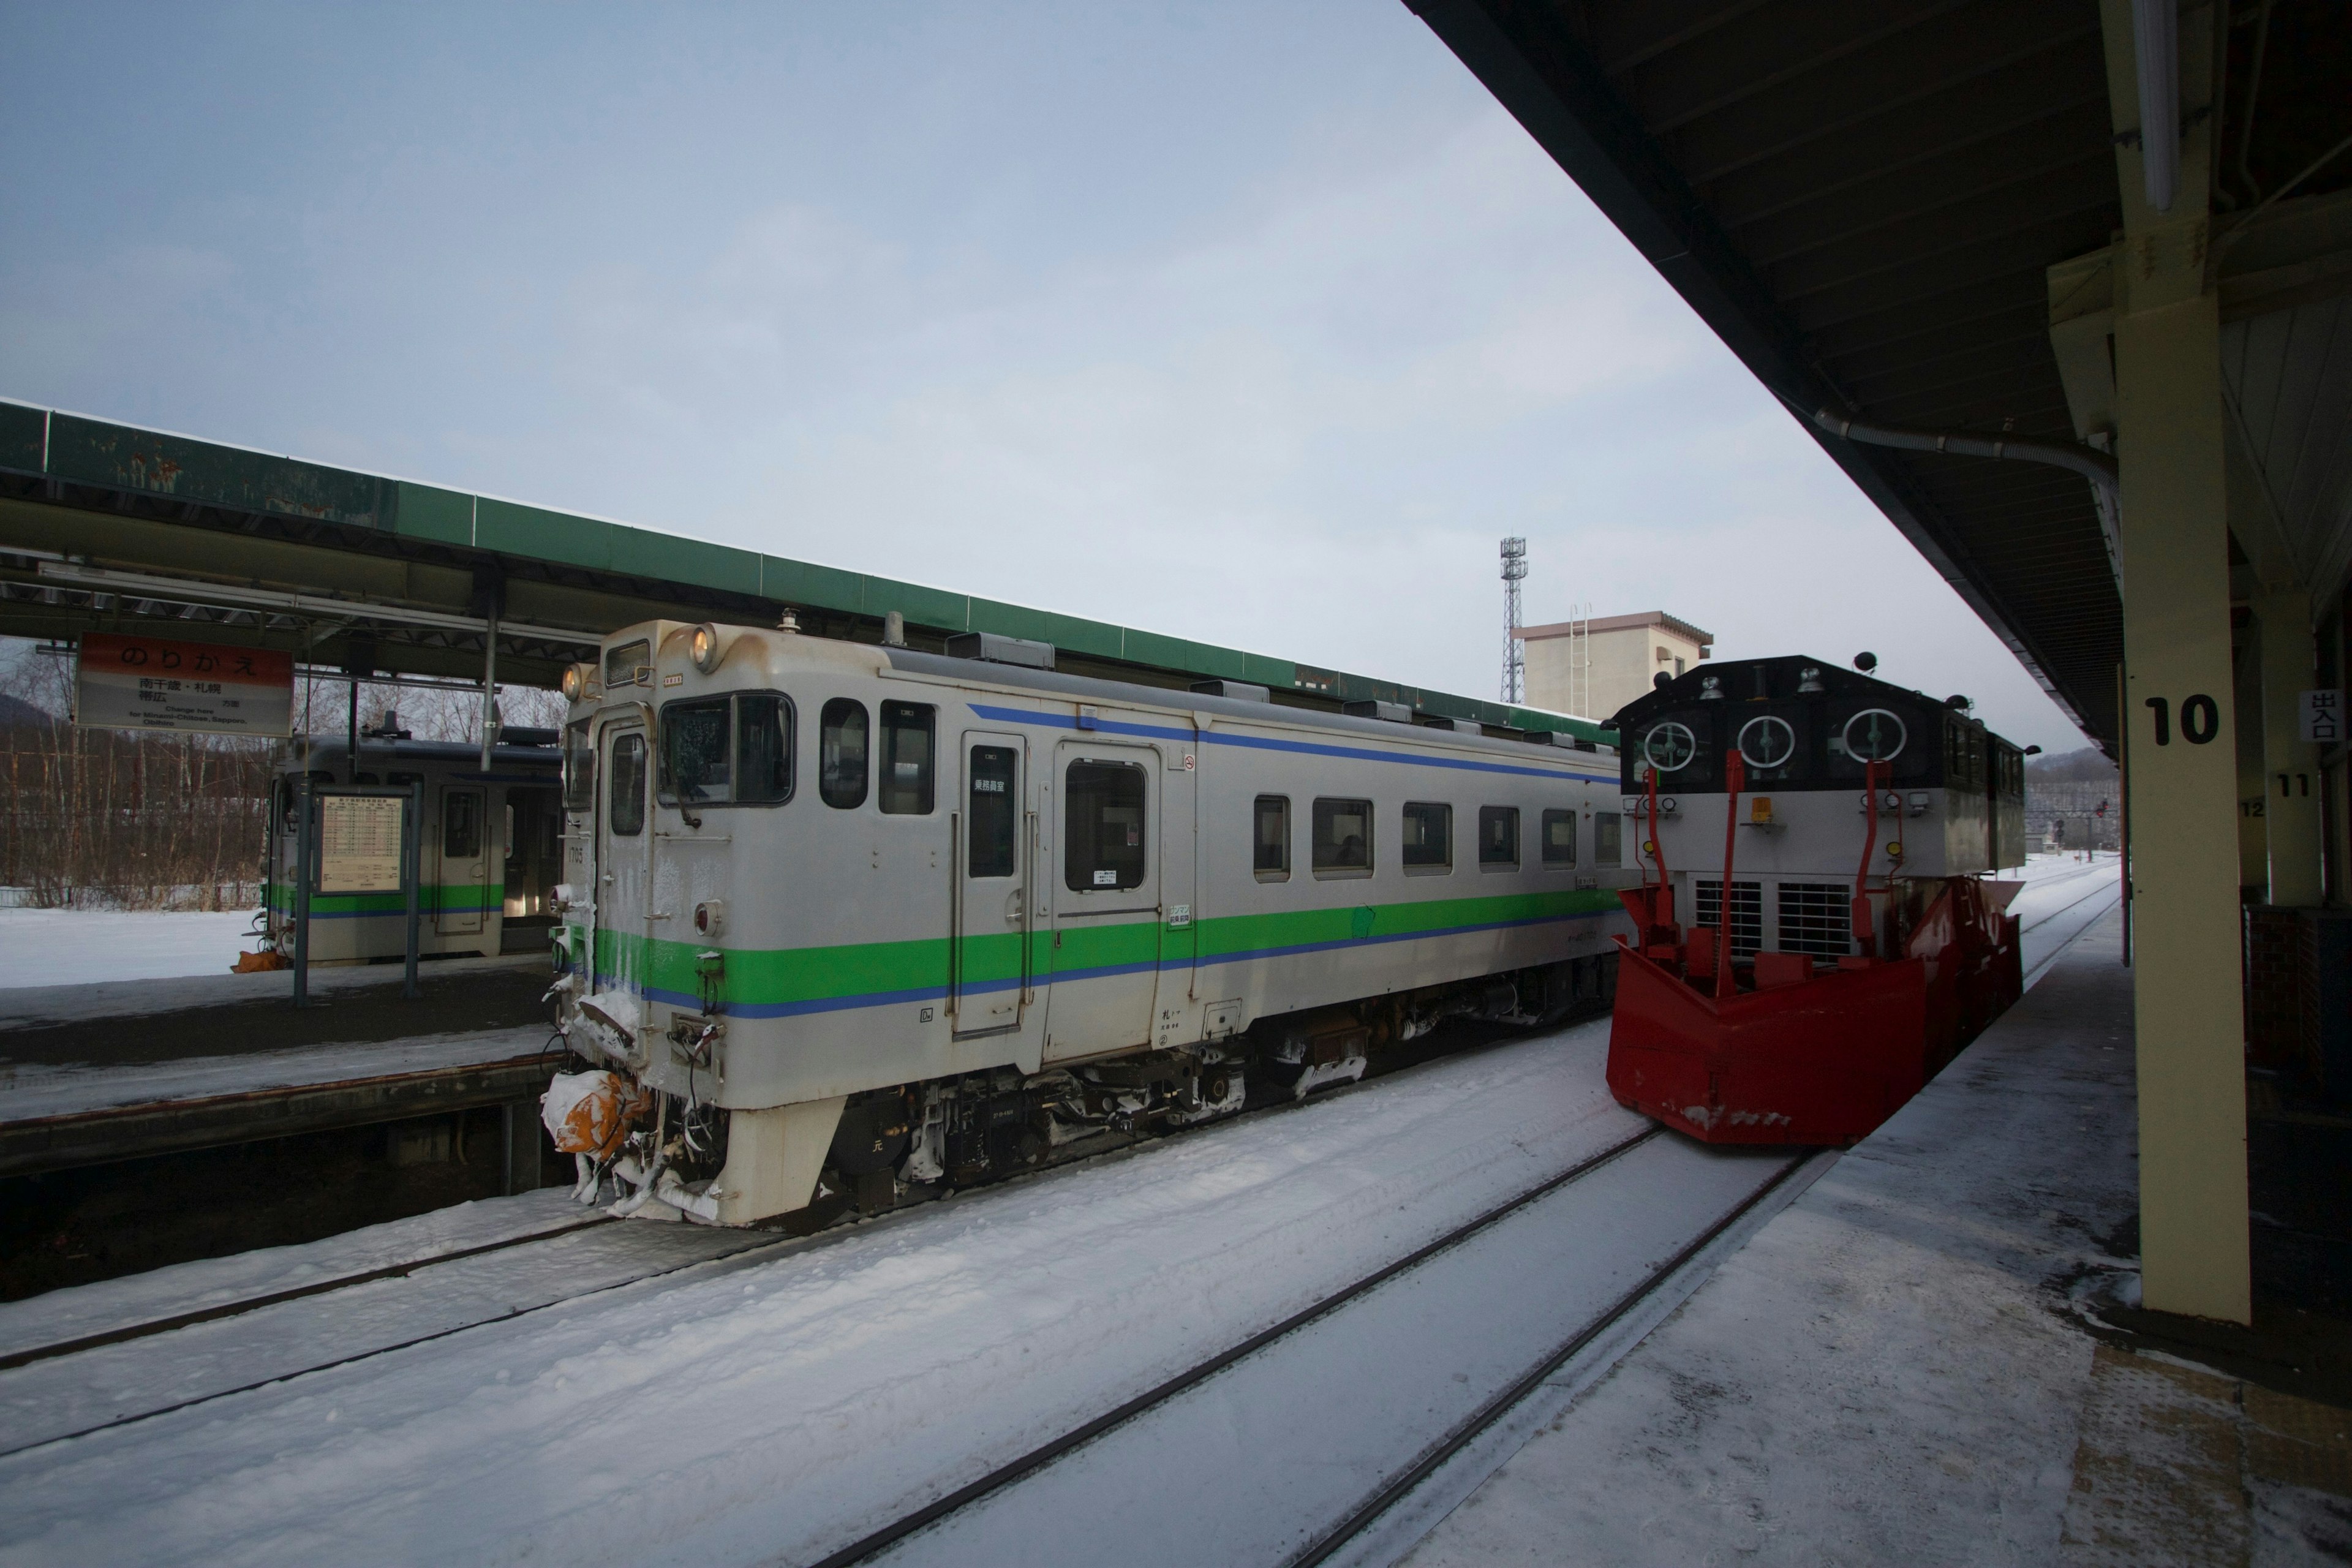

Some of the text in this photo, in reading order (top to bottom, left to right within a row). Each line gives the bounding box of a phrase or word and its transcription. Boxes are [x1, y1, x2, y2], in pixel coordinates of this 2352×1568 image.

[121, 646, 257, 677] のりかえ
[139, 677, 222, 695] 南千歳・札幌
[138, 691, 167, 703] 帯広
[222, 699, 240, 708] 方面
[2145, 694, 2218, 745] 10
[2312, 693, 2336, 738] 出入口
[975, 779, 1005, 792] 乗務員室
[2277, 774, 2309, 797] 11
[2241, 802, 2264, 818] 12
[569, 846, 583, 864] 1705
[872, 1139, 883, 1153] 元
